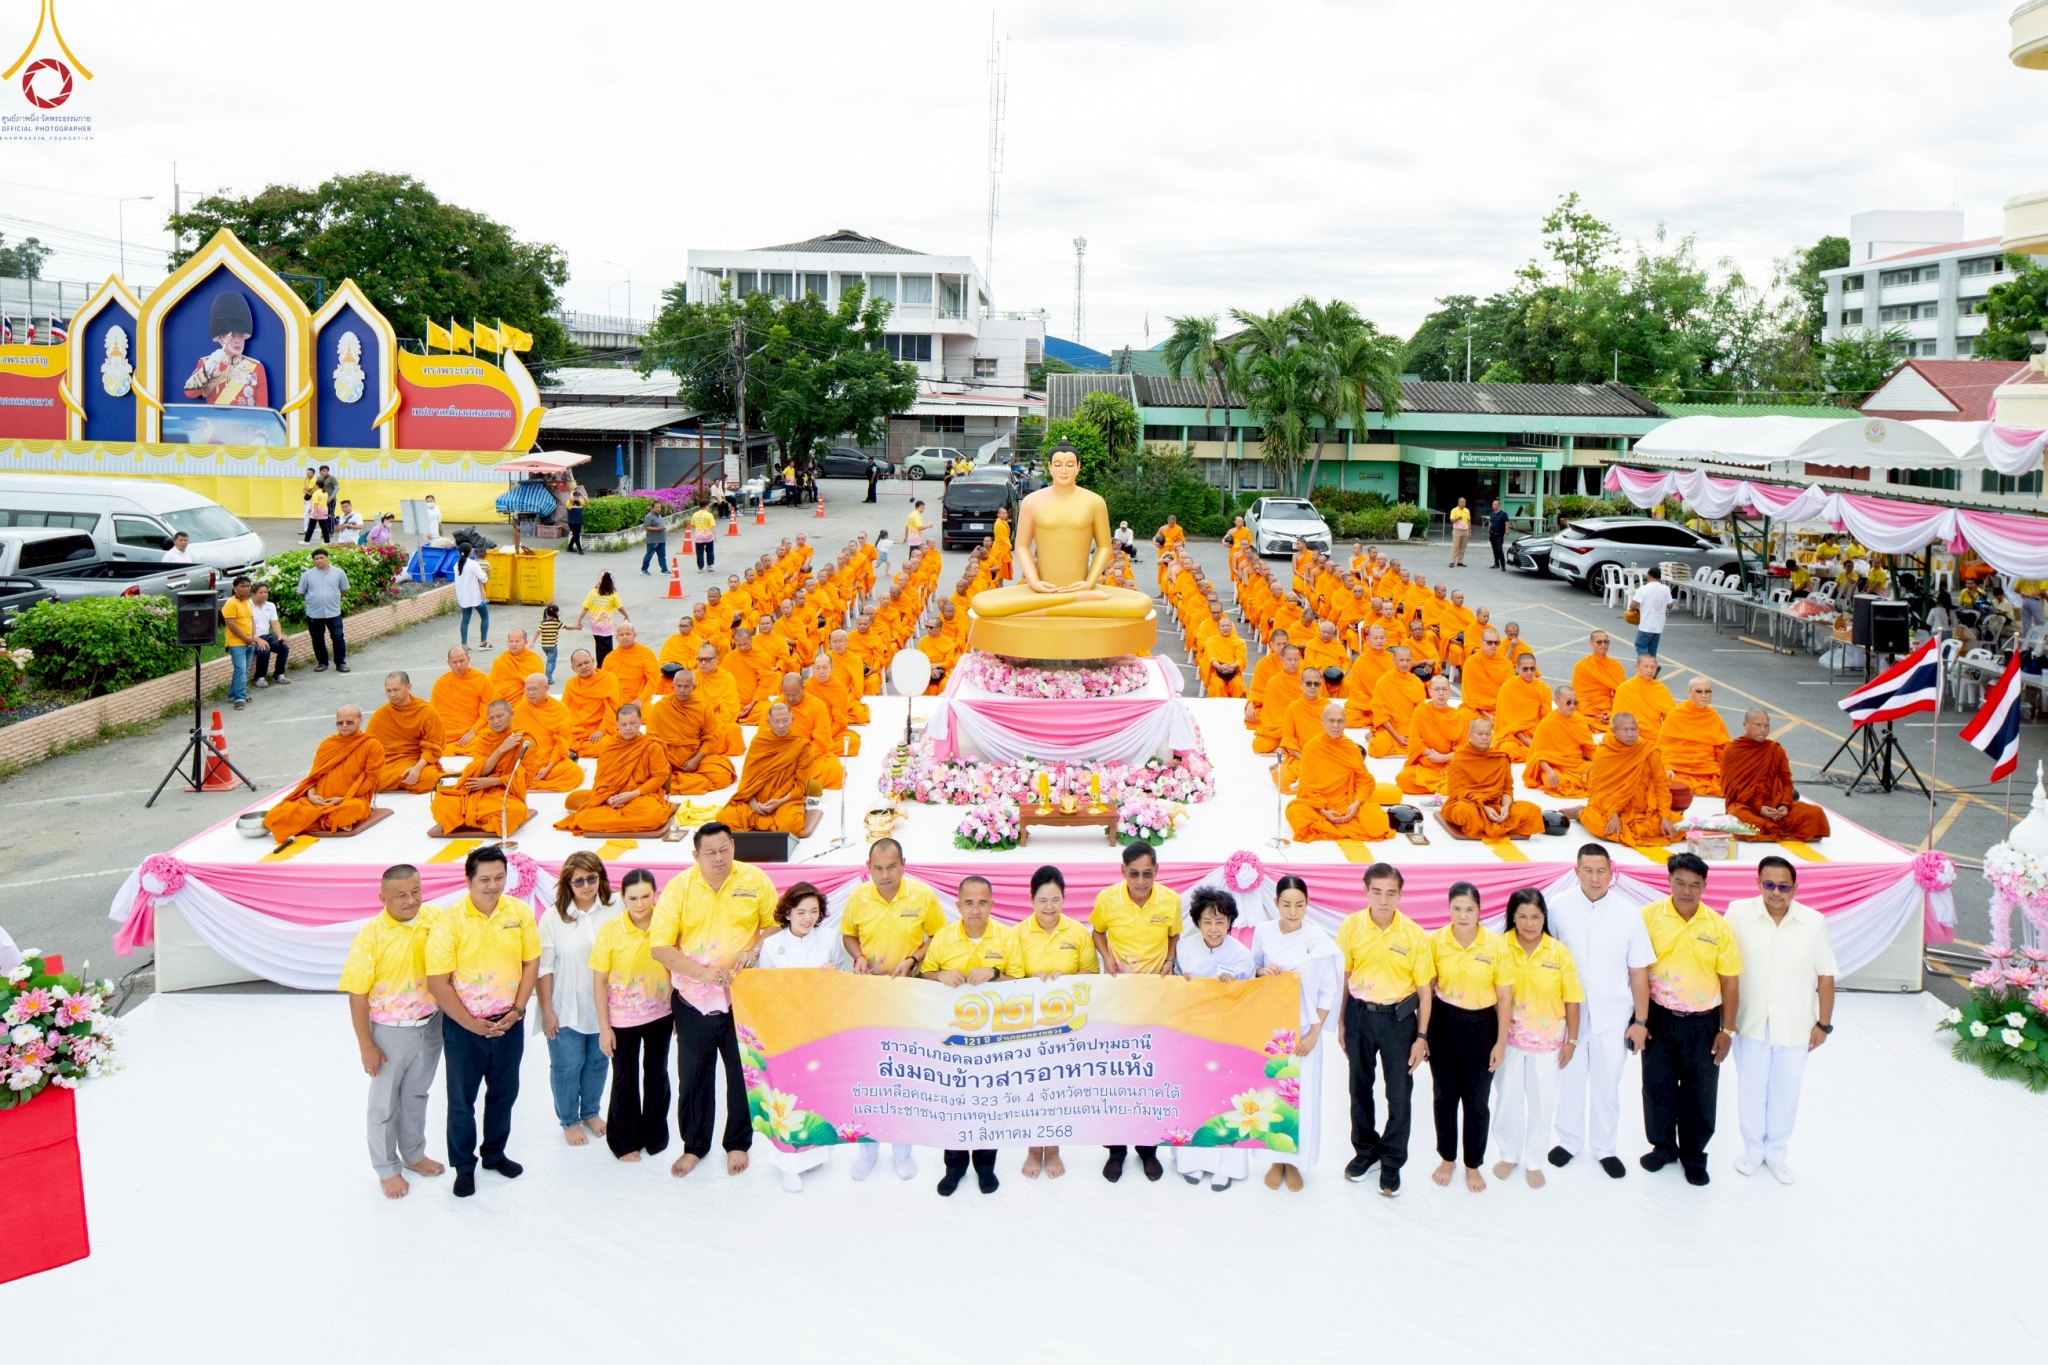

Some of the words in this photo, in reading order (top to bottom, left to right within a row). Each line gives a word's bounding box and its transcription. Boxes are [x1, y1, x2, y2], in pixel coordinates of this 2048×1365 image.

[423, 364, 484, 377] ทรงพระเจริญ
[1072, 981, 1091, 1006] ปี
[880, 1040, 1031, 1065] ชาวอำเภอคลองหลวง
[1037, 1033, 1152, 1055] จังหวัดปทุมธานี
[963, 1037, 981, 1046] 121
[996, 1028, 1062, 1043] อำเภอคลองหลวง
[878, 1052, 1154, 1088] ส่งมอบข้าวสารอาหารแห้ง
[852, 1083, 966, 1107] ช่วยเหลือคณะสงฆ์
[971, 1095, 998, 1106] 323
[1004, 1091, 1021, 1104] วัด
[1026, 1092, 1034, 1102] 4
[1040, 1082, 1180, 1101] จังหวัดชายแดนภาคใต้
[958, 1131, 973, 1142] 31
[979, 1126, 1031, 1142] สิงหาคม
[1037, 1125, 1073, 1138] 2568
